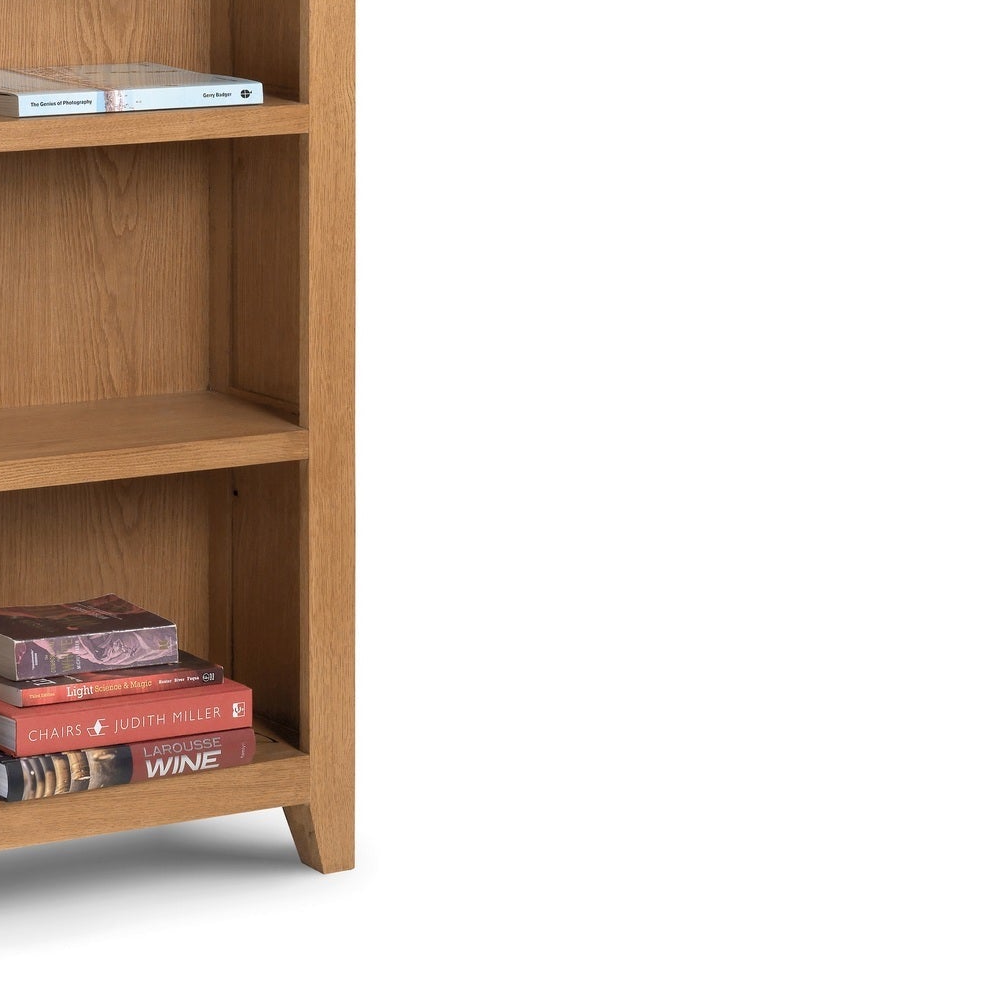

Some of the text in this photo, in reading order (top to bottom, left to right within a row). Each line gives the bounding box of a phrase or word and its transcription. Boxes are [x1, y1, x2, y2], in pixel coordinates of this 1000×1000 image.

[66, 685, 94, 699] Light
[94, 683, 122, 693] Science
[130, 680, 152, 689] Magic
[114, 706, 221, 734] JUDITH MILLER
[27, 726, 82, 743] CHAIRS
[143, 738, 222, 758] LAROUSSE
[144, 750, 222, 779] WINE
